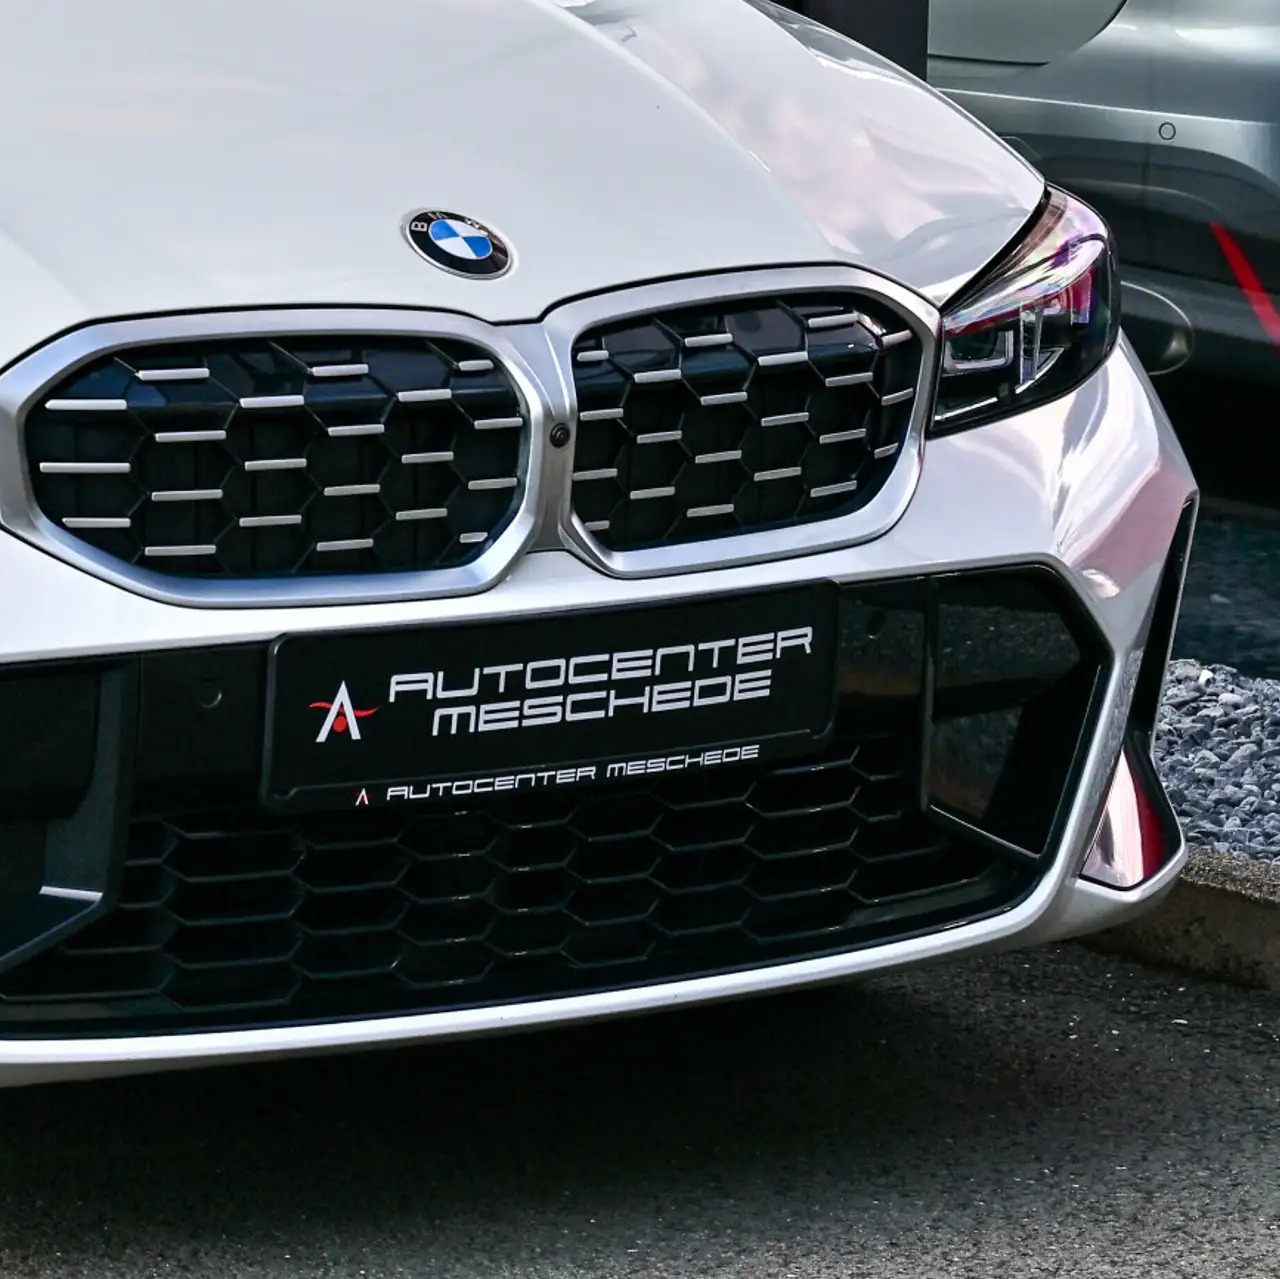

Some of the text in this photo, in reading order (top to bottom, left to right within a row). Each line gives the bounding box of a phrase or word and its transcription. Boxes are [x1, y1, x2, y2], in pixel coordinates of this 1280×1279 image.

[388, 626, 813, 703] AUTOCENTER
[432, 669, 772, 737] MESCHEDE
[386, 744, 760, 801] AUTOCENTER MESCHEDE
